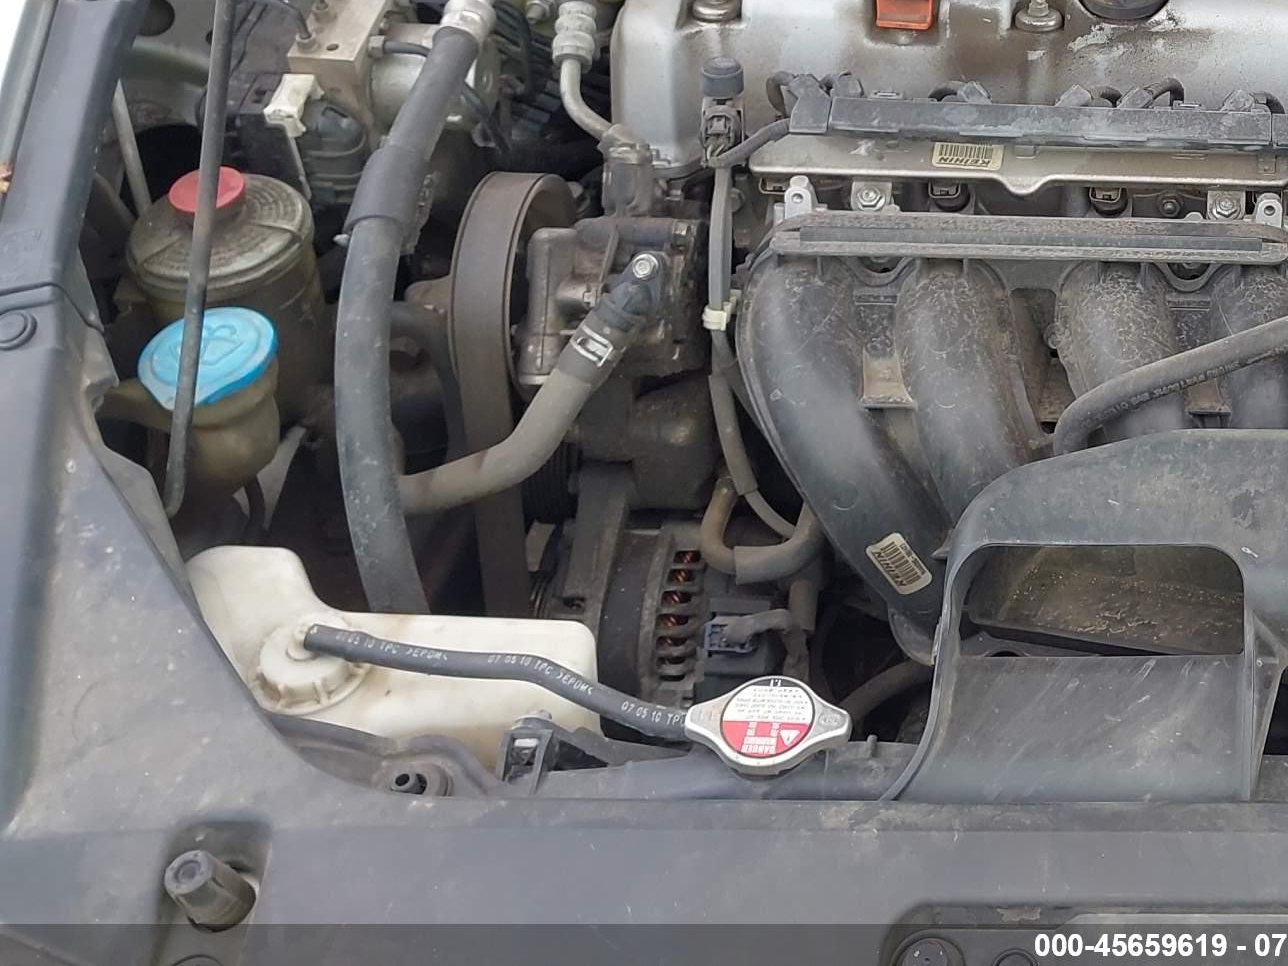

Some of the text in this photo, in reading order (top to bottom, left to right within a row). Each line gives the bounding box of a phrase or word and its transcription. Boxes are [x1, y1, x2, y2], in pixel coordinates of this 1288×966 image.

[938, 156, 991, 166] KEIHIN
[875, 552, 906, 586] KEIHIN
[379, 641, 398, 654] TPC
[520, 656, 531, 667] 10
[534, 661, 551, 675] TPC
[620, 701, 634, 712] 07
[635, 706, 648, 719] 05
[651, 710, 662, 723] 10
[740, 744, 777, 755] DANGER
